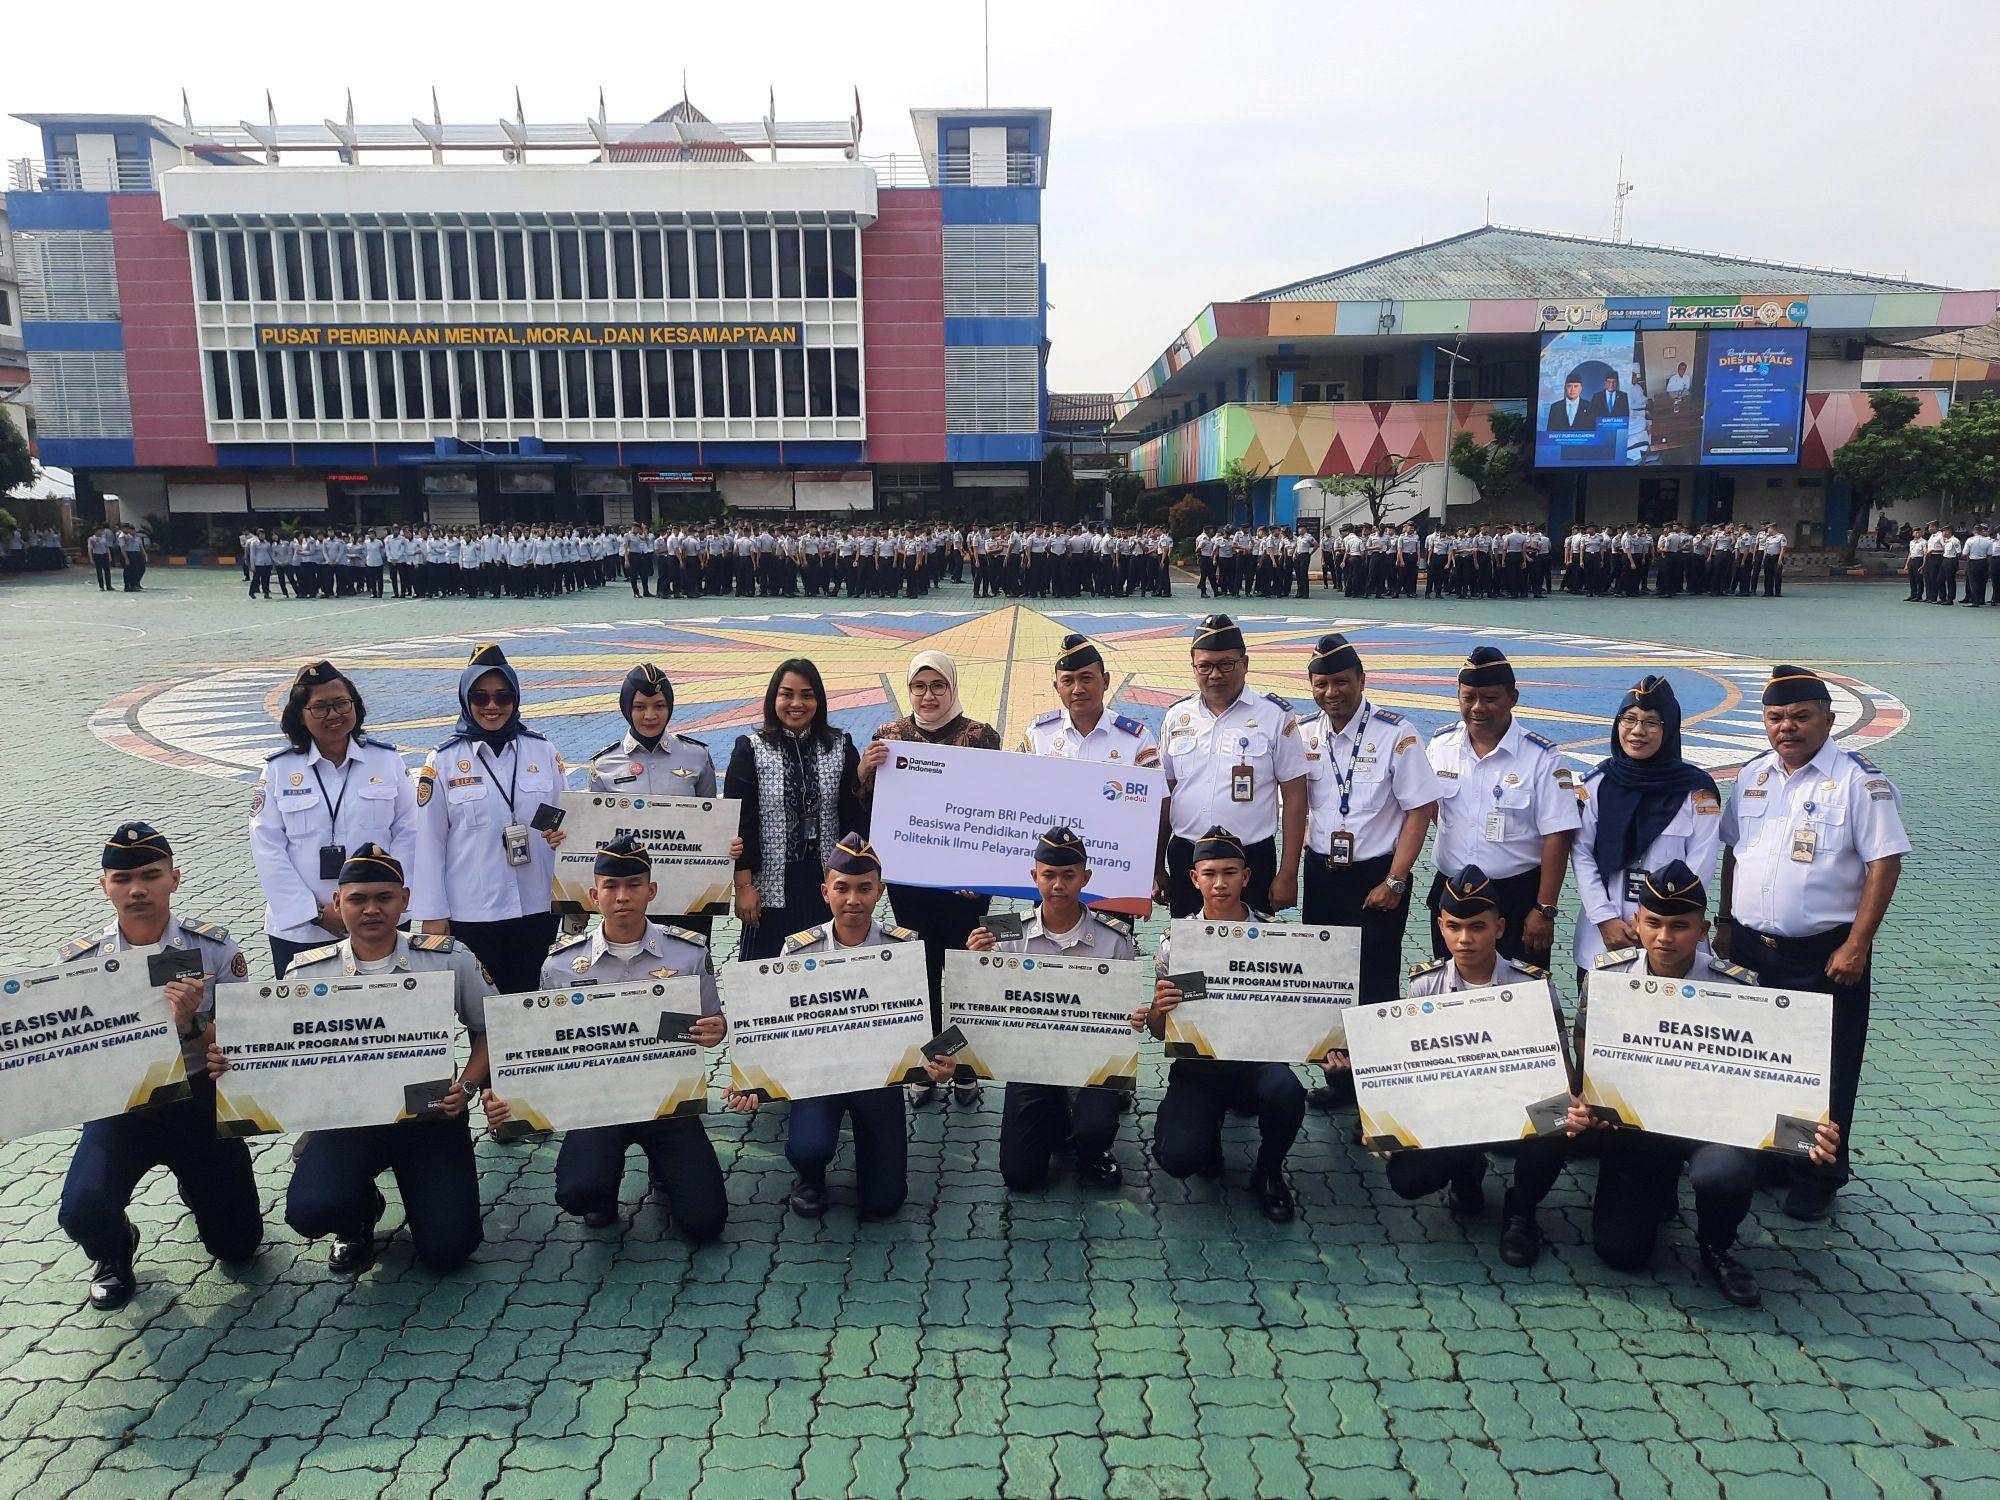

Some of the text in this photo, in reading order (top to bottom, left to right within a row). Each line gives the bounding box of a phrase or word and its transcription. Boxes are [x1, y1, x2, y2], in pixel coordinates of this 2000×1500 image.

[262, 329, 321, 344] PUSAT
[328, 329, 439, 344] PEMBINAAN
[650, 327, 795, 342] KESAMAPTAAN
[1719, 356, 1792, 366] DIES NATALIS
[909, 766, 942, 774] Indonesia
[910, 757, 945, 768] Danantara
[1126, 782, 1148, 796] BRI
[1124, 795, 1147, 803] peduli
[945, 803, 1084, 830] Program BRI Peduli TJSL
[909, 815, 961, 831] Beasiswa
[964, 821, 1029, 840] Pendidikan
[648, 843, 702, 852] AKADEMIK
[894, 830, 950, 847] Politeknik
[953, 836, 979, 850] Ilmu
[1086, 855, 1131, 872] marang
[1229, 960, 1303, 974] BEASISWA
[1205, 977, 1354, 990] RBAIK PROGRAM STUDI NAUTIKA
[790, 988, 868, 1008] BEASISWA
[1005, 990, 1081, 1005] BEASISWA
[1226, 992, 1248, 1001] ILMU
[1249, 994, 1301, 1003] PELAYARAN
[1302, 996, 1352, 1005] SEMARANG
[734, 998, 923, 1029] IPK TERBAIK PROGRAM STUDI TEKNIKA
[950, 1002, 965, 1011] IPK
[967, 1003, 1008, 1013] TERBAIK
[1010, 1006, 1059, 1016] PROGRAM
[1061, 1009, 1090, 1019] STUDI
[0, 1005, 94, 1036] EASISWA
[22, 1031, 57, 1047] NON
[62, 1012, 141, 1039] AKADEMIK
[293, 1017, 386, 1035] BEASISWA
[736, 1014, 924, 1044] POLITEKNIK ILMU PELAYARAN SEMARANG
[950, 1017, 1132, 1035] POLITEKNIK ILMU PELAYARAN SEMARANG
[556, 1022, 639, 1041] BEASISWA
[1659, 1020, 1753, 1044] BEASISWA
[0, 1026, 168, 1071] LMU PELAYARAN SEMARANG
[223, 1031, 449, 1055] IPK TERBAIK PROGRAM STUDI NAUTIKA
[506, 1051, 523, 1060] IPK
[525, 1046, 570, 1058] TERBAIK
[573, 1041, 627, 1054] PROGRAM
[1411, 1031, 1492, 1052] BEASISWA
[1623, 1033, 1792, 1064] BANTUAN PENDIDIKAN
[291, 1057, 318, 1067] ILMU
[321, 1052, 384, 1065] PELAYARAN
[387, 1048, 447, 1059] SEMARANG
[498, 1049, 697, 1077] POLITEKNIK ILMU PELAYARAN SEMARANG
[1355, 1065, 1392, 1075] BANTUAN
[1501, 1049, 1519, 1057] DAN
[1520, 1043, 1560, 1054] TERLUAR)
[1593, 1048, 1820, 1086] POLITEKNIK ILMU PELAYARAN SEMARANG
[1362, 1059, 1556, 1089] POLITEKNIK ILMU PELAYARAN SEMARANG
